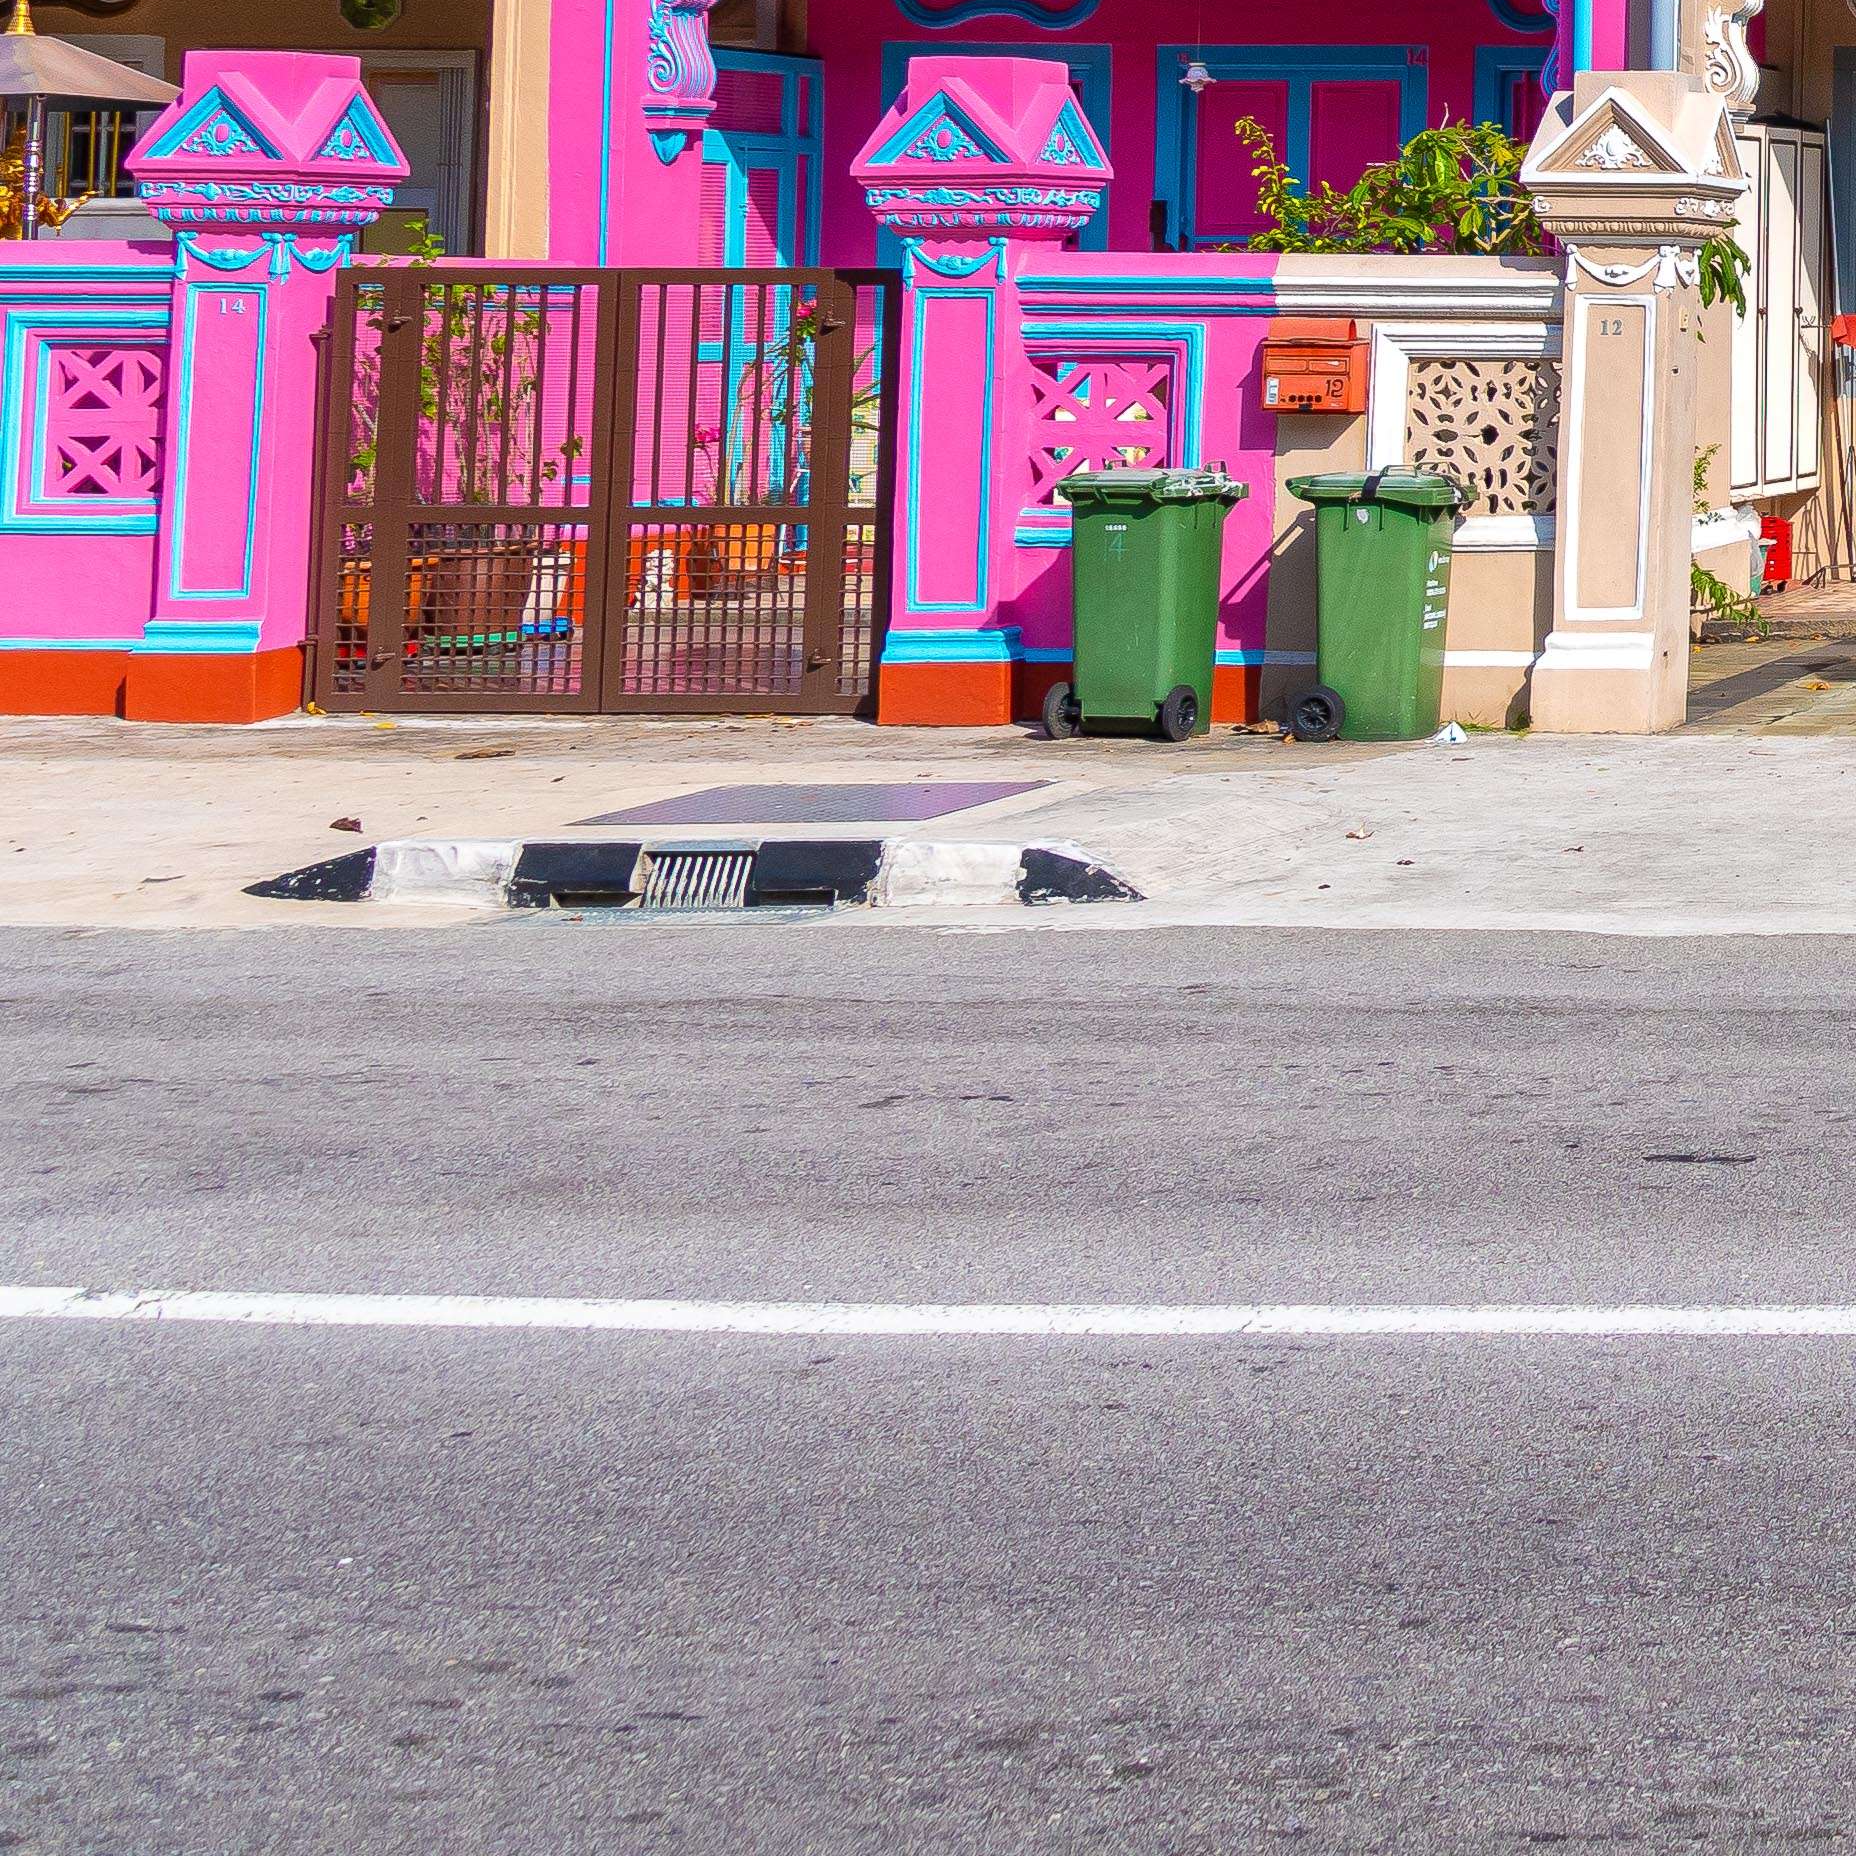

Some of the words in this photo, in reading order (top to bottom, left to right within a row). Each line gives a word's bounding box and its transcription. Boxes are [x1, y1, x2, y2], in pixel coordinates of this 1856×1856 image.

[1408, 47, 1426, 66] 14
[220, 297, 247, 315] 14
[1600, 319, 1623, 336] 12
[1325, 378, 1344, 398] 12
